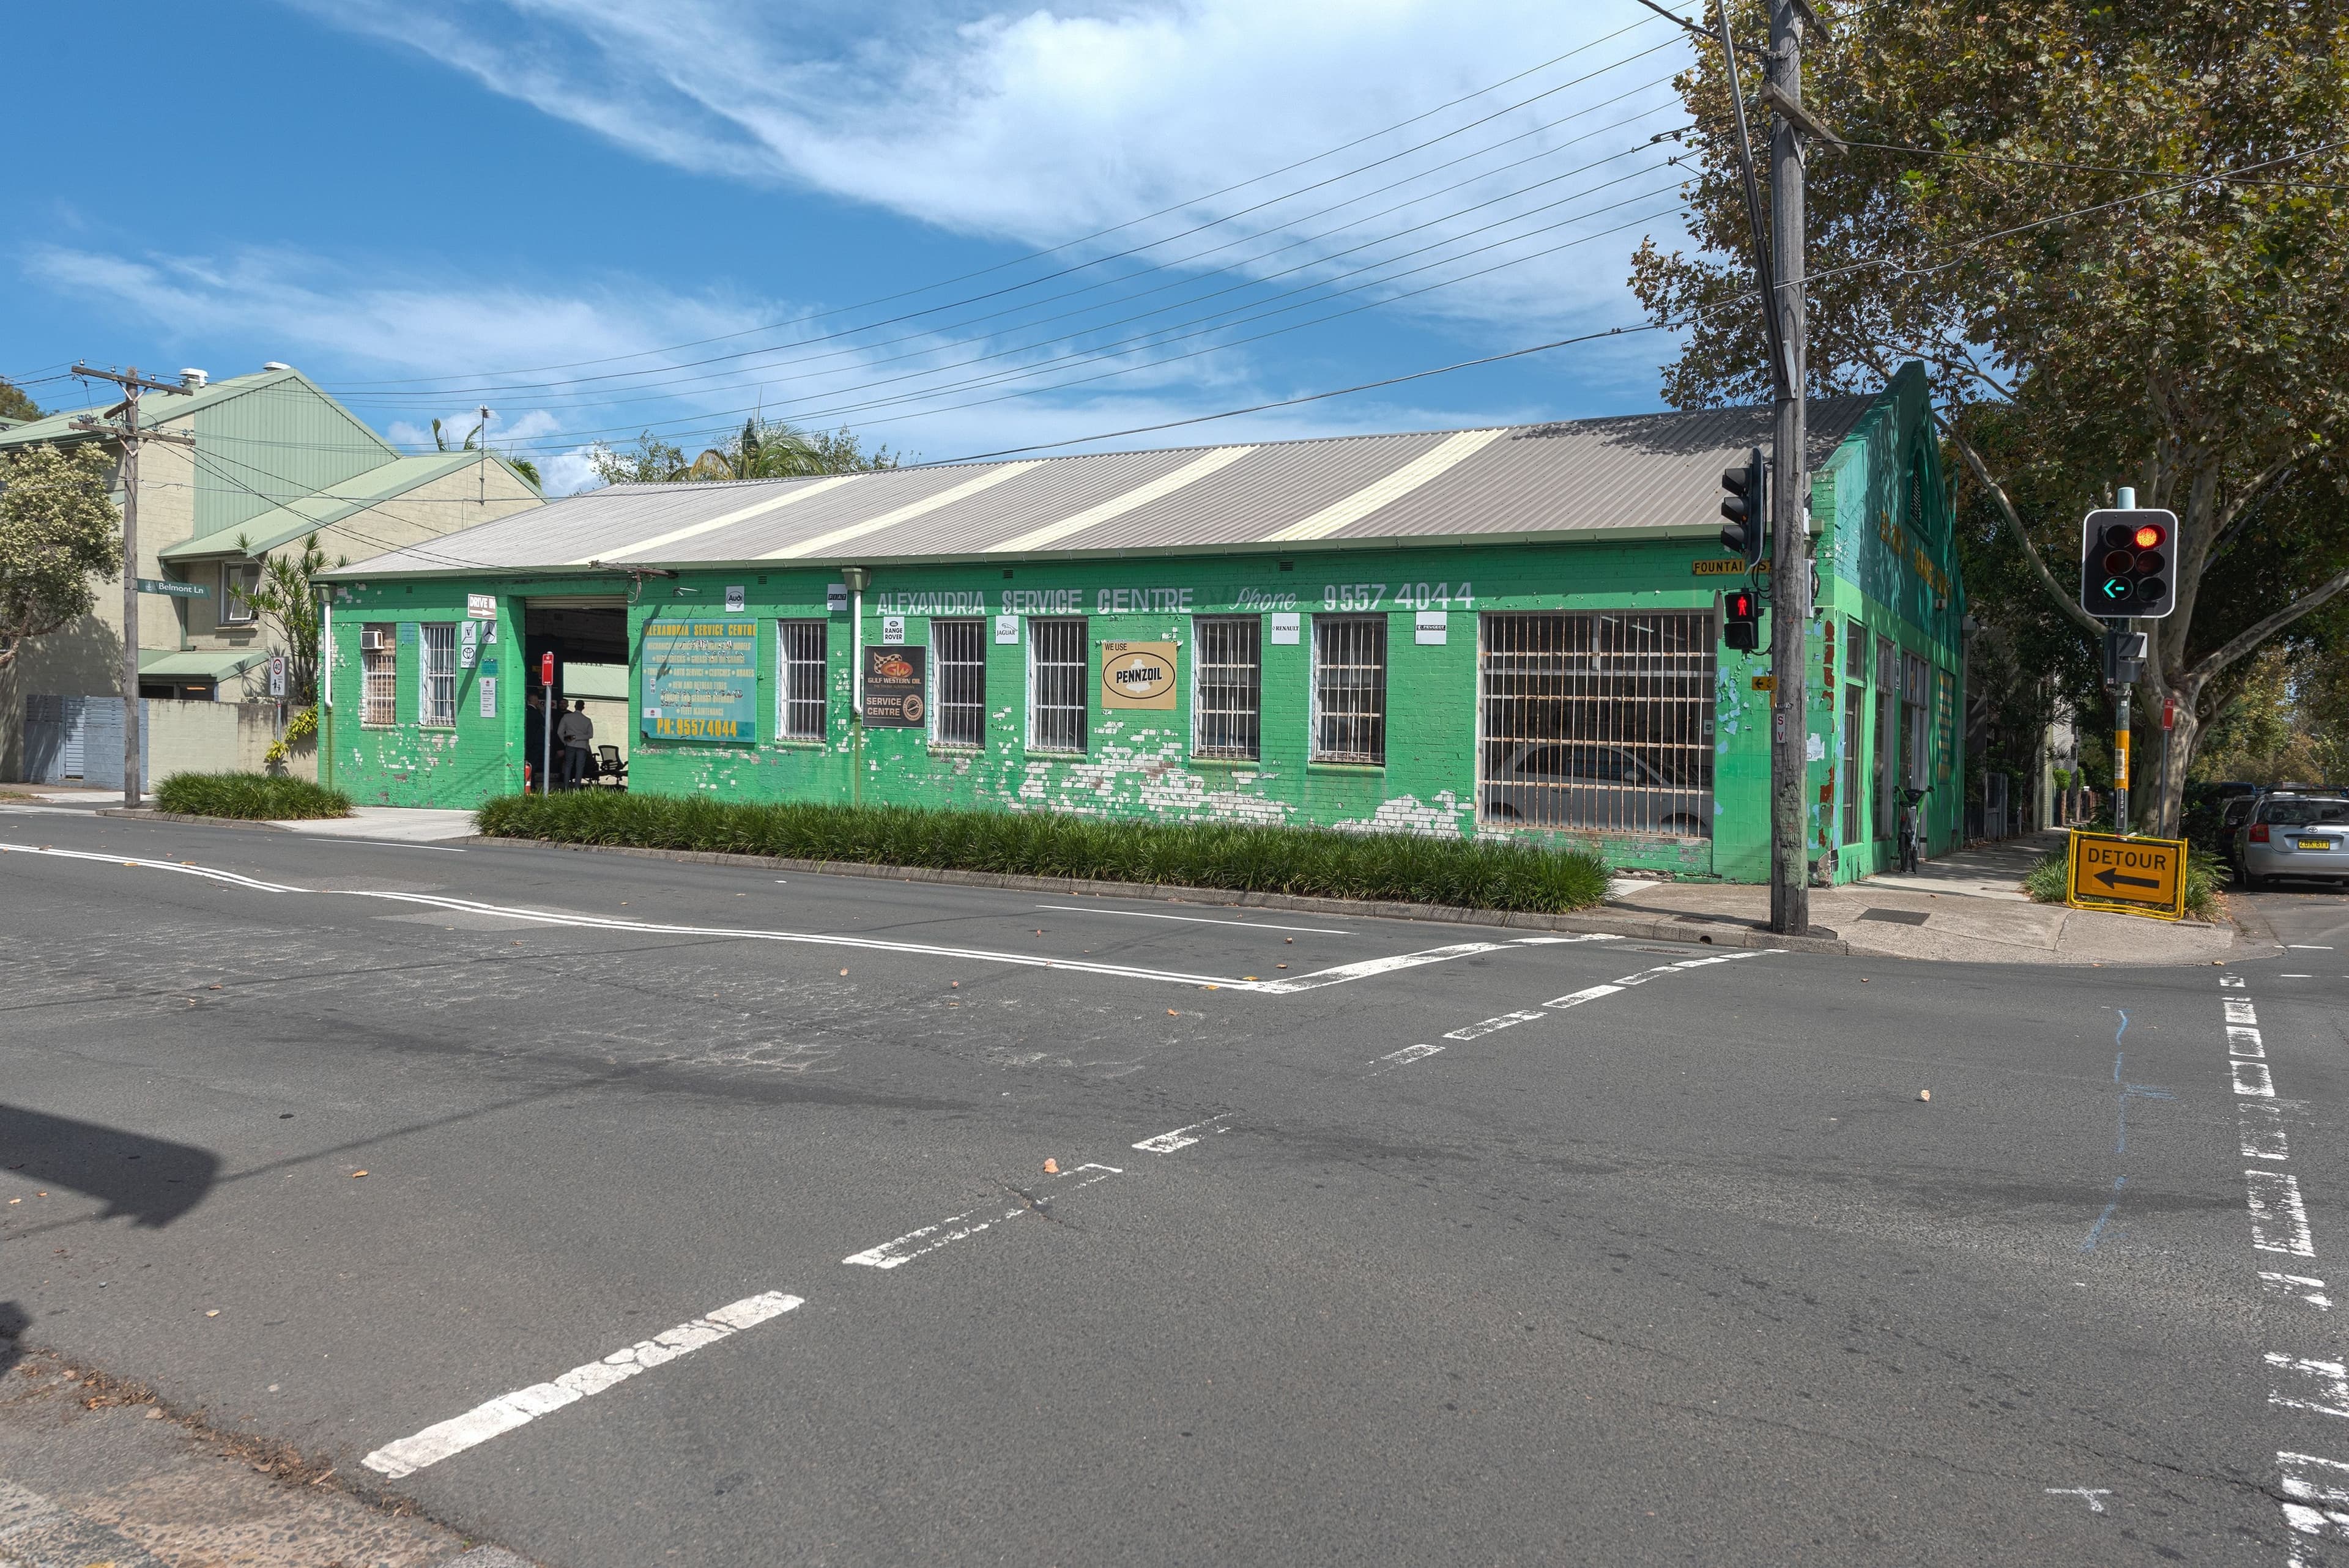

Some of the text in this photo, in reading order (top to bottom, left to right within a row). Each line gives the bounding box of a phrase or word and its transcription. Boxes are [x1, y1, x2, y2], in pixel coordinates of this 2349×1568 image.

[1695, 561, 1743, 572] FOUNTAI
[159, 583, 192, 593] Belmont
[470, 596, 495, 609] DRIVE IN
[876, 582, 1475, 615] ALEXANDRIA SERVICE CENTRE Phone 9557 4044
[646, 624, 689, 636] ALEXANDRIA
[694, 624, 723, 636] SERVICE
[1116, 667, 1162, 684] PENNZOIL
[866, 697, 901, 706] SERVICE
[867, 708, 900, 716] CENTRE
[1778, 716, 1784, 725] S
[1778, 731, 1784, 741] V
[2088, 848, 2166, 870] DETOUR
